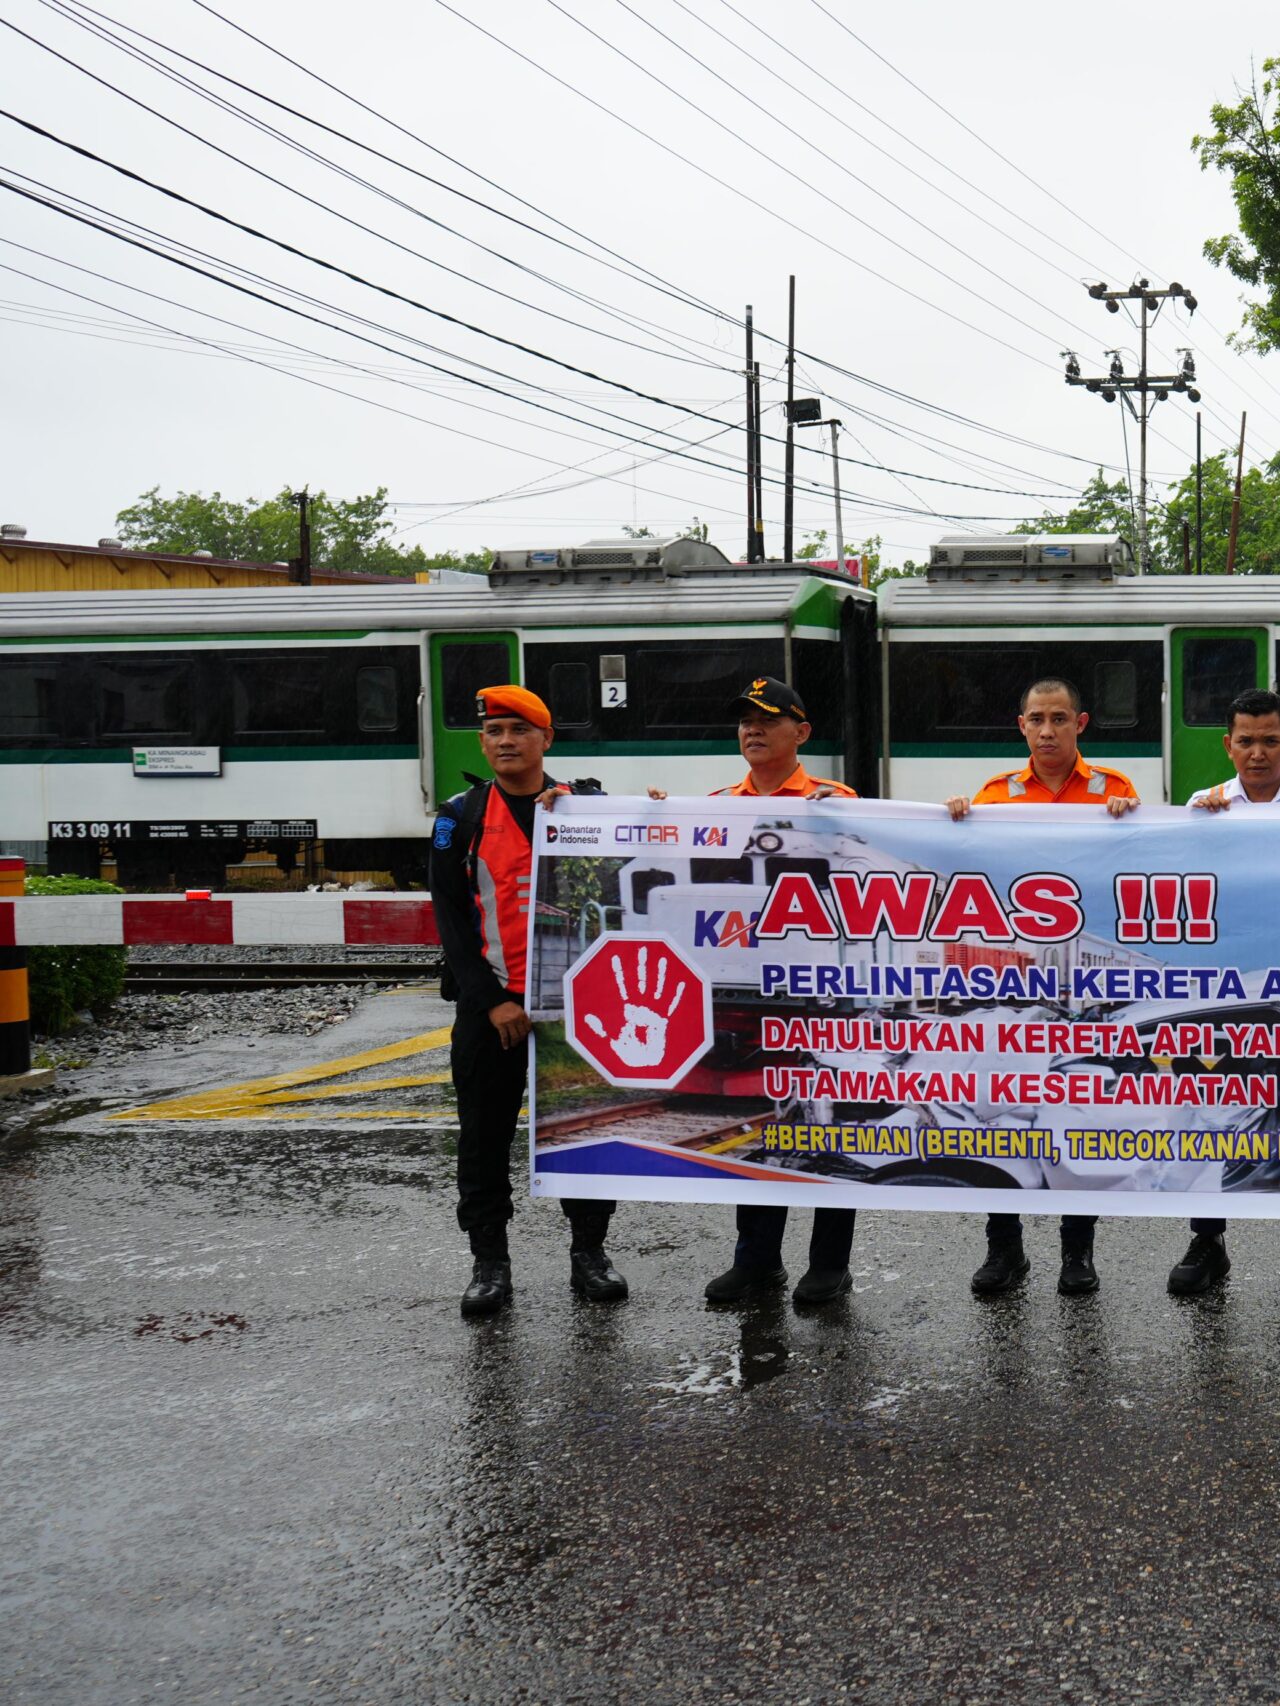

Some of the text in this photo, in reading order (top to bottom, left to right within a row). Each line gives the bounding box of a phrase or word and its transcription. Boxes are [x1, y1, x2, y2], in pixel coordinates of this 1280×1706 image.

[608, 687, 618, 702] 2
[52, 823, 131, 838] K3 3 09 11
[560, 825, 601, 834] Danantara
[615, 825, 679, 843] CITAR
[693, 827, 727, 846] KAI
[560, 835, 599, 844] Indonesia
[755, 872, 1217, 943] AWAS !!!
[762, 964, 1056, 999] PERLINTASAN
[1073, 968, 1247, 999] KERETA
[764, 1019, 984, 1052] DAHULUKAN
[1001, 1023, 1142, 1055] KERETA
[1153, 1025, 1212, 1055] API
[766, 1069, 976, 1103] UTAMAKAN
[991, 1073, 1277, 1106] KESELAMATAN
[763, 1122, 911, 1155] #BERTEMAN
[917, 1126, 1061, 1165] (BERHENTI,
[1065, 1129, 1174, 1161] TENGOK
[1179, 1131, 1269, 1161] KANAN
